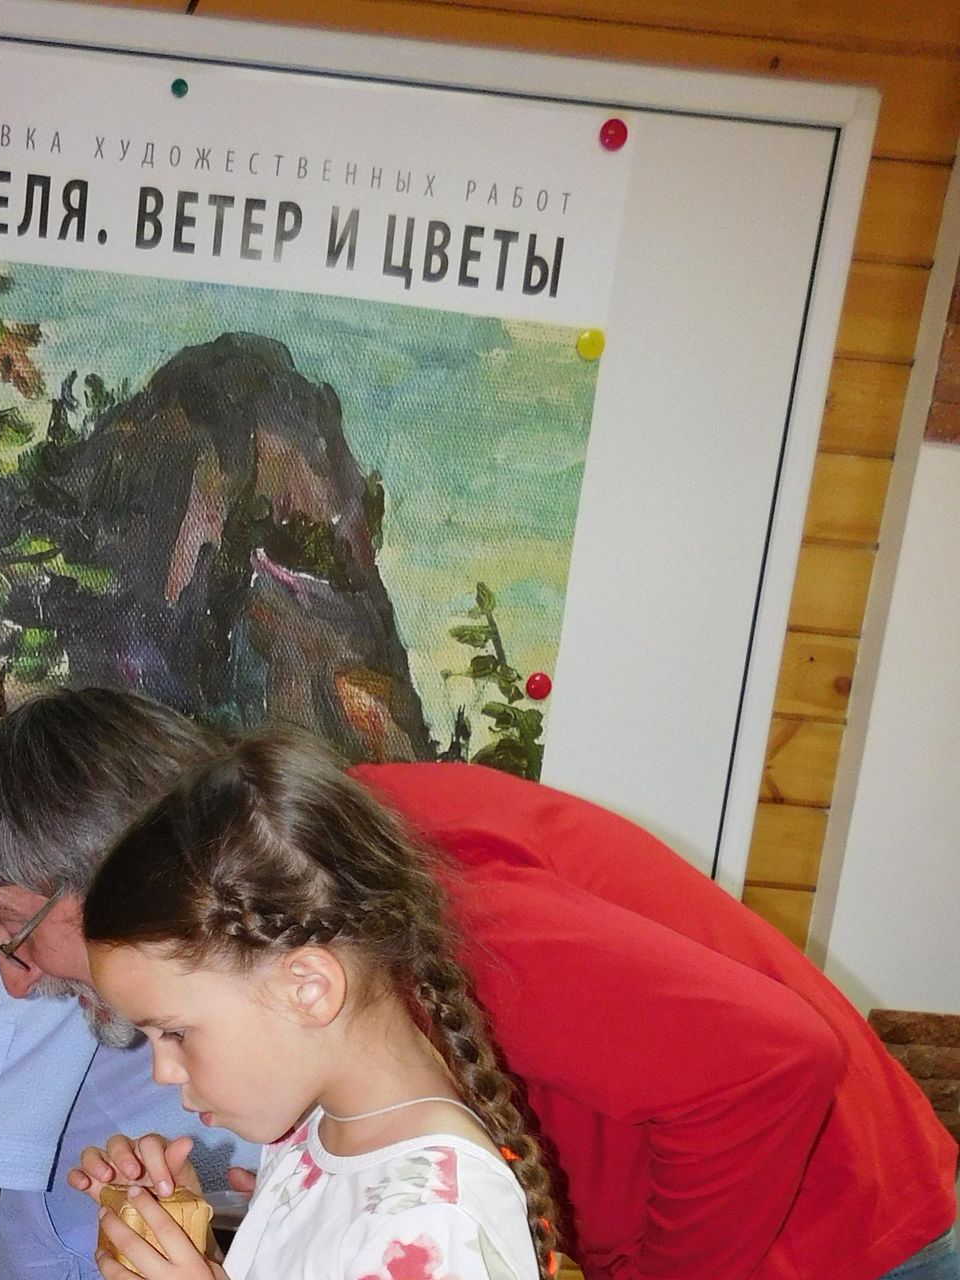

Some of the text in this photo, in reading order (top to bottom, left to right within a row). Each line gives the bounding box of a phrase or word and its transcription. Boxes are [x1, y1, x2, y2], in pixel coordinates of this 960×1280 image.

[93, 135, 436, 198] ХУДОЖЕСТВЕННЫХ
[465, 179, 572, 215] РАБОТ
[134, 185, 303, 263] ВЕТЕР
[325, 205, 361, 272] И
[381, 213, 565, 299] ЦВЕТЫ
